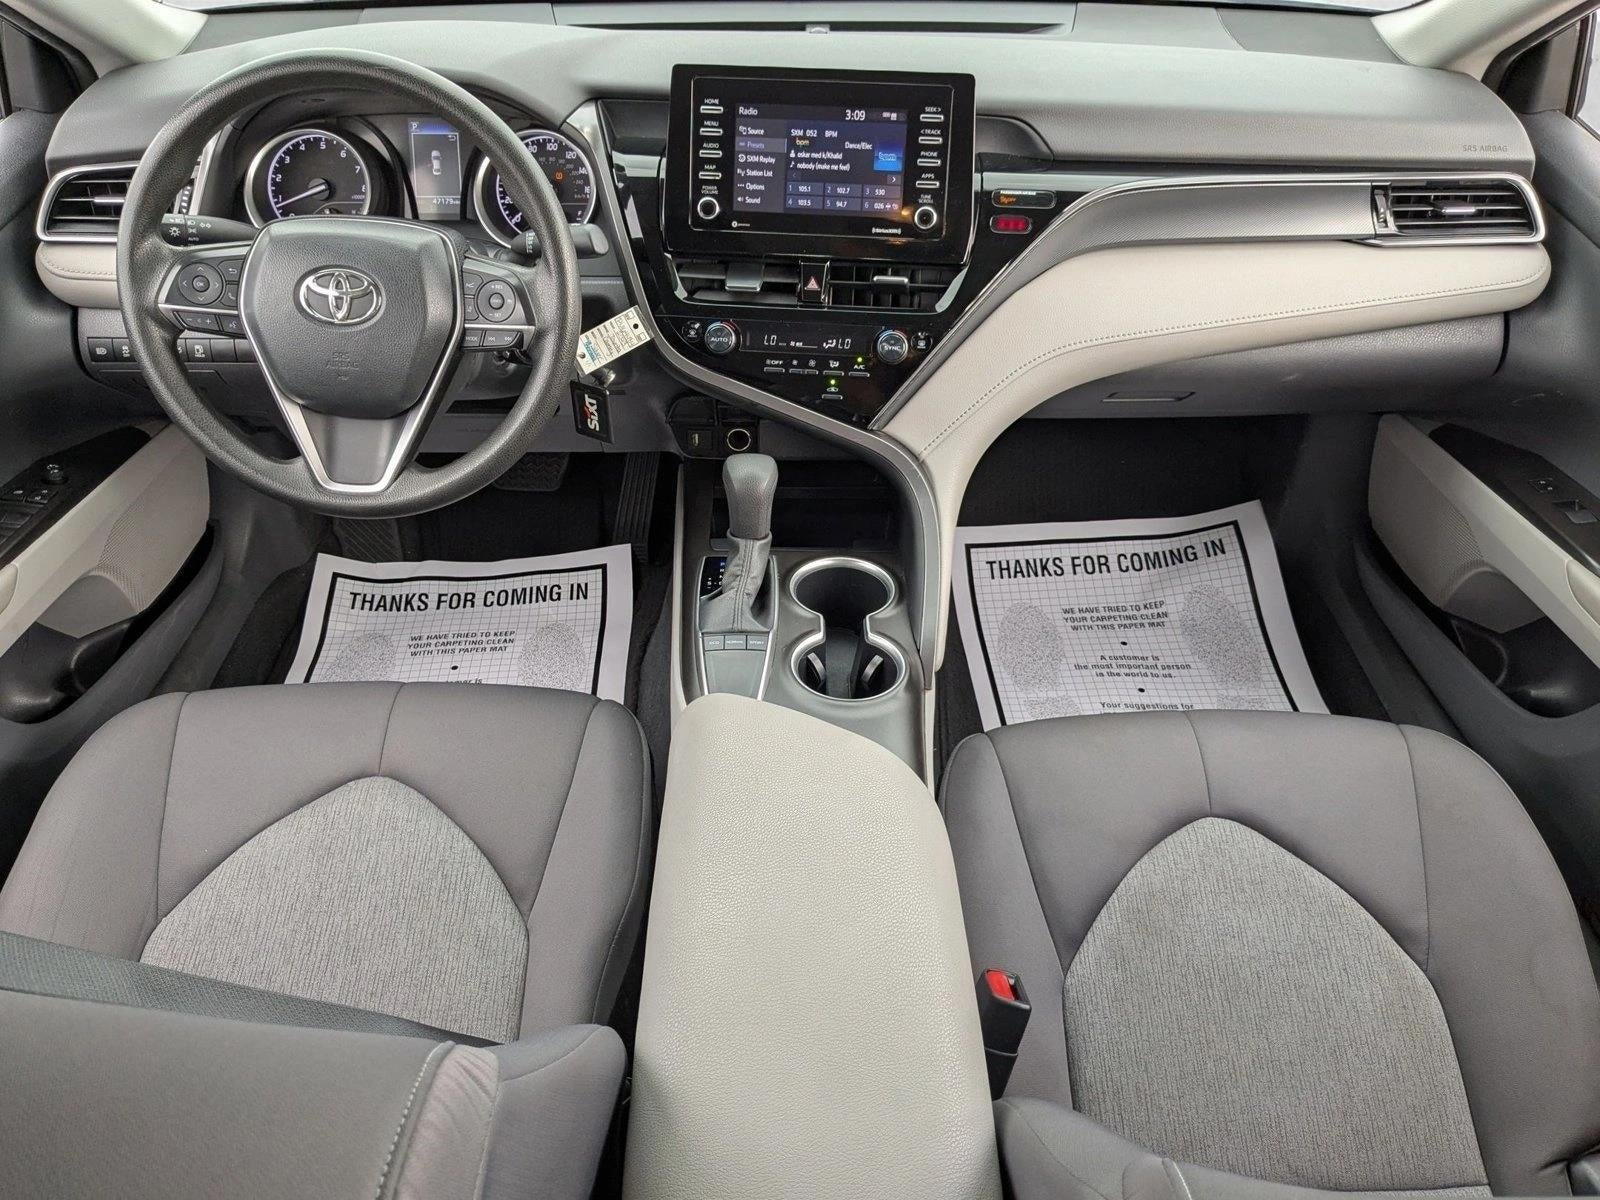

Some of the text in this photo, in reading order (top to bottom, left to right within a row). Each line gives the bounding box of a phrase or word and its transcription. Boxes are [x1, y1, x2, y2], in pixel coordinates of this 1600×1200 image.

[739, 107, 758, 115] Radio
[845, 109, 866, 121] 3:09
[748, 127, 764, 135] Source
[825, 130, 838, 138] BPM
[747, 141, 765, 149] Presets
[845, 141, 872, 150] Dance/Elec
[566, 151, 576, 159] 120
[285, 156, 290, 164] 3
[797, 162, 814, 171] nobody
[276, 174, 282, 182] 2
[746, 183, 765, 191] Options
[986, 538, 1226, 580] THANKS FOR COMING IN
[350, 582, 589, 612] THANKS FOR COMING IN
[1078, 606, 1100, 614] HAVE
[1102, 605, 1127, 613] TRIED
[1143, 600, 1165, 610] KEEP
[1090, 614, 1138, 622] CARPETING
[1140, 611, 1168, 620] CLEAN
[1118, 622, 1145, 630] PAPER
[434, 639, 483, 648] CARPETING
[1124, 702, 1178, 710] suggestions
